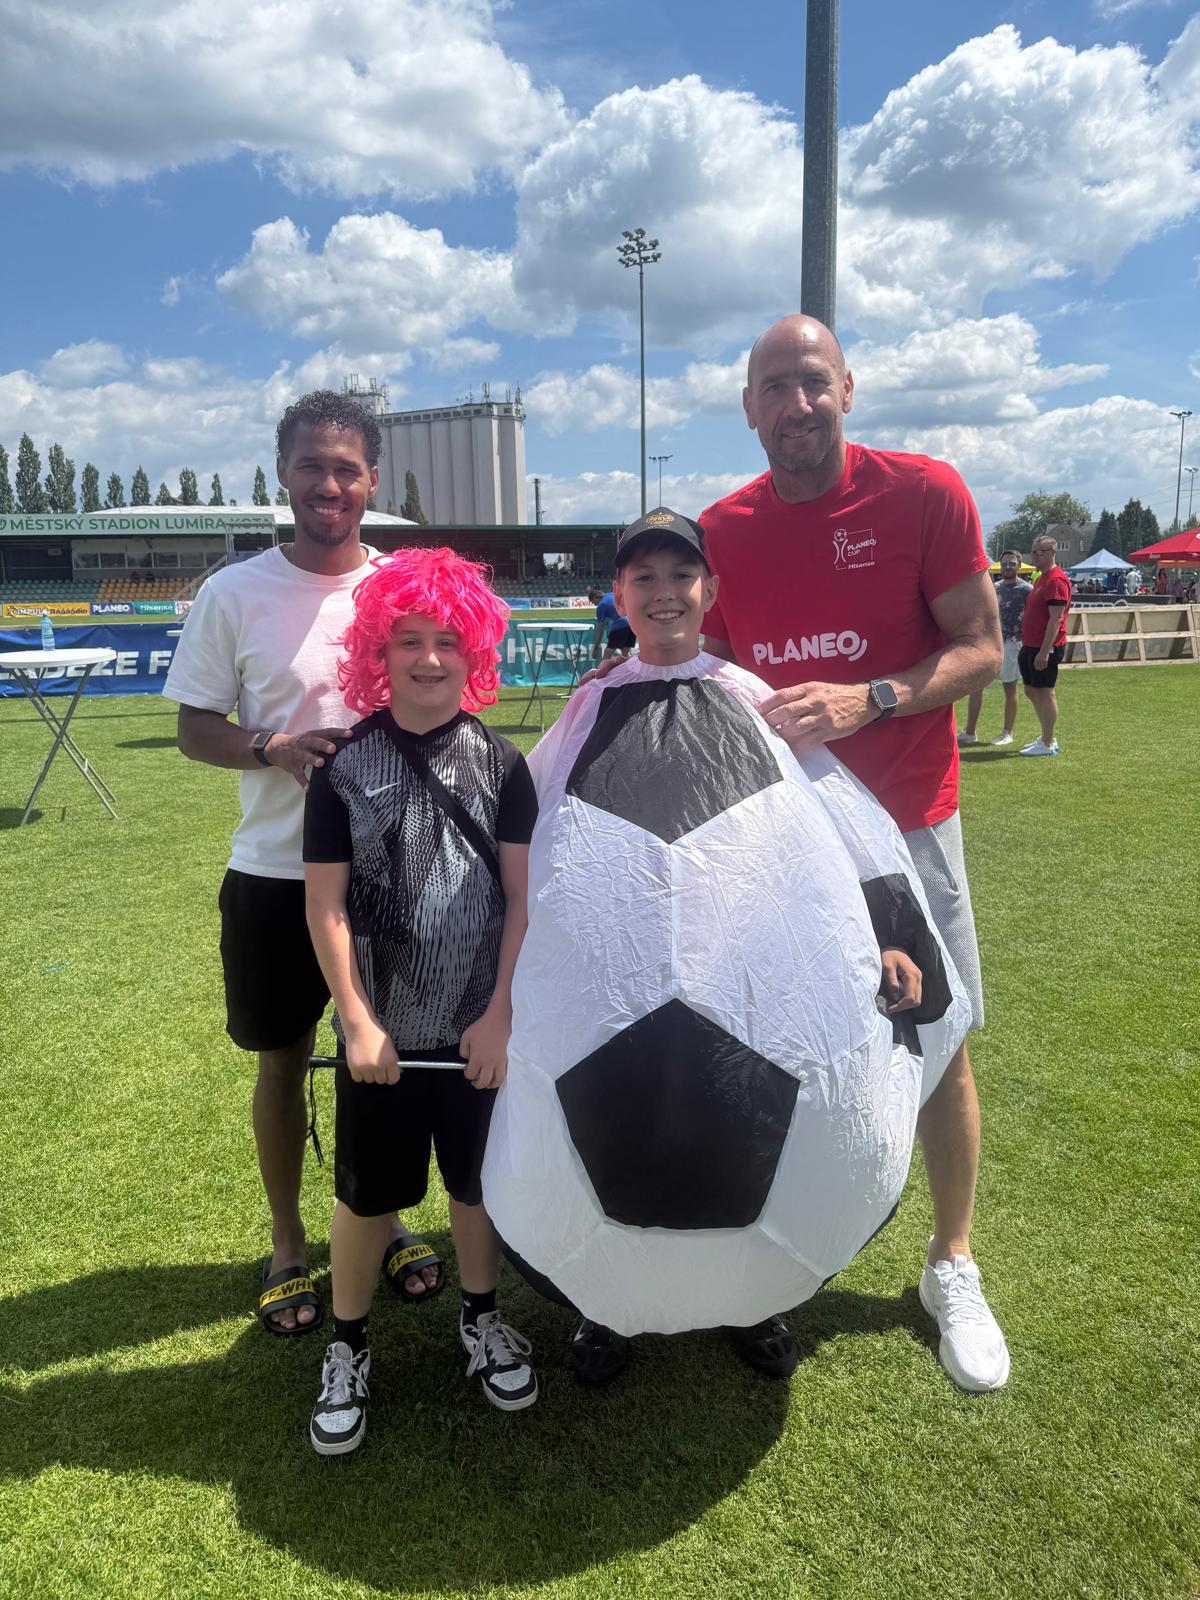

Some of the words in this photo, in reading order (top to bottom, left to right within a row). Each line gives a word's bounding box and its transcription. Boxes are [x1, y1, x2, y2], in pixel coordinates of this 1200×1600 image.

[11, 516, 84, 530] MĚSTSKÝ
[89, 518, 160, 530] STADION
[165, 516, 226, 529] LUMÍRA
[847, 539, 876, 551] PLANEO
[847, 549, 860, 557] CUP
[848, 561, 876, 569] Hisense
[92, 604, 130, 613] PLANEO
[752, 630, 867, 666] PLANEO
[387, 1246, 433, 1274] FF-WHI
[258, 1280, 312, 1304] FF-WHI
